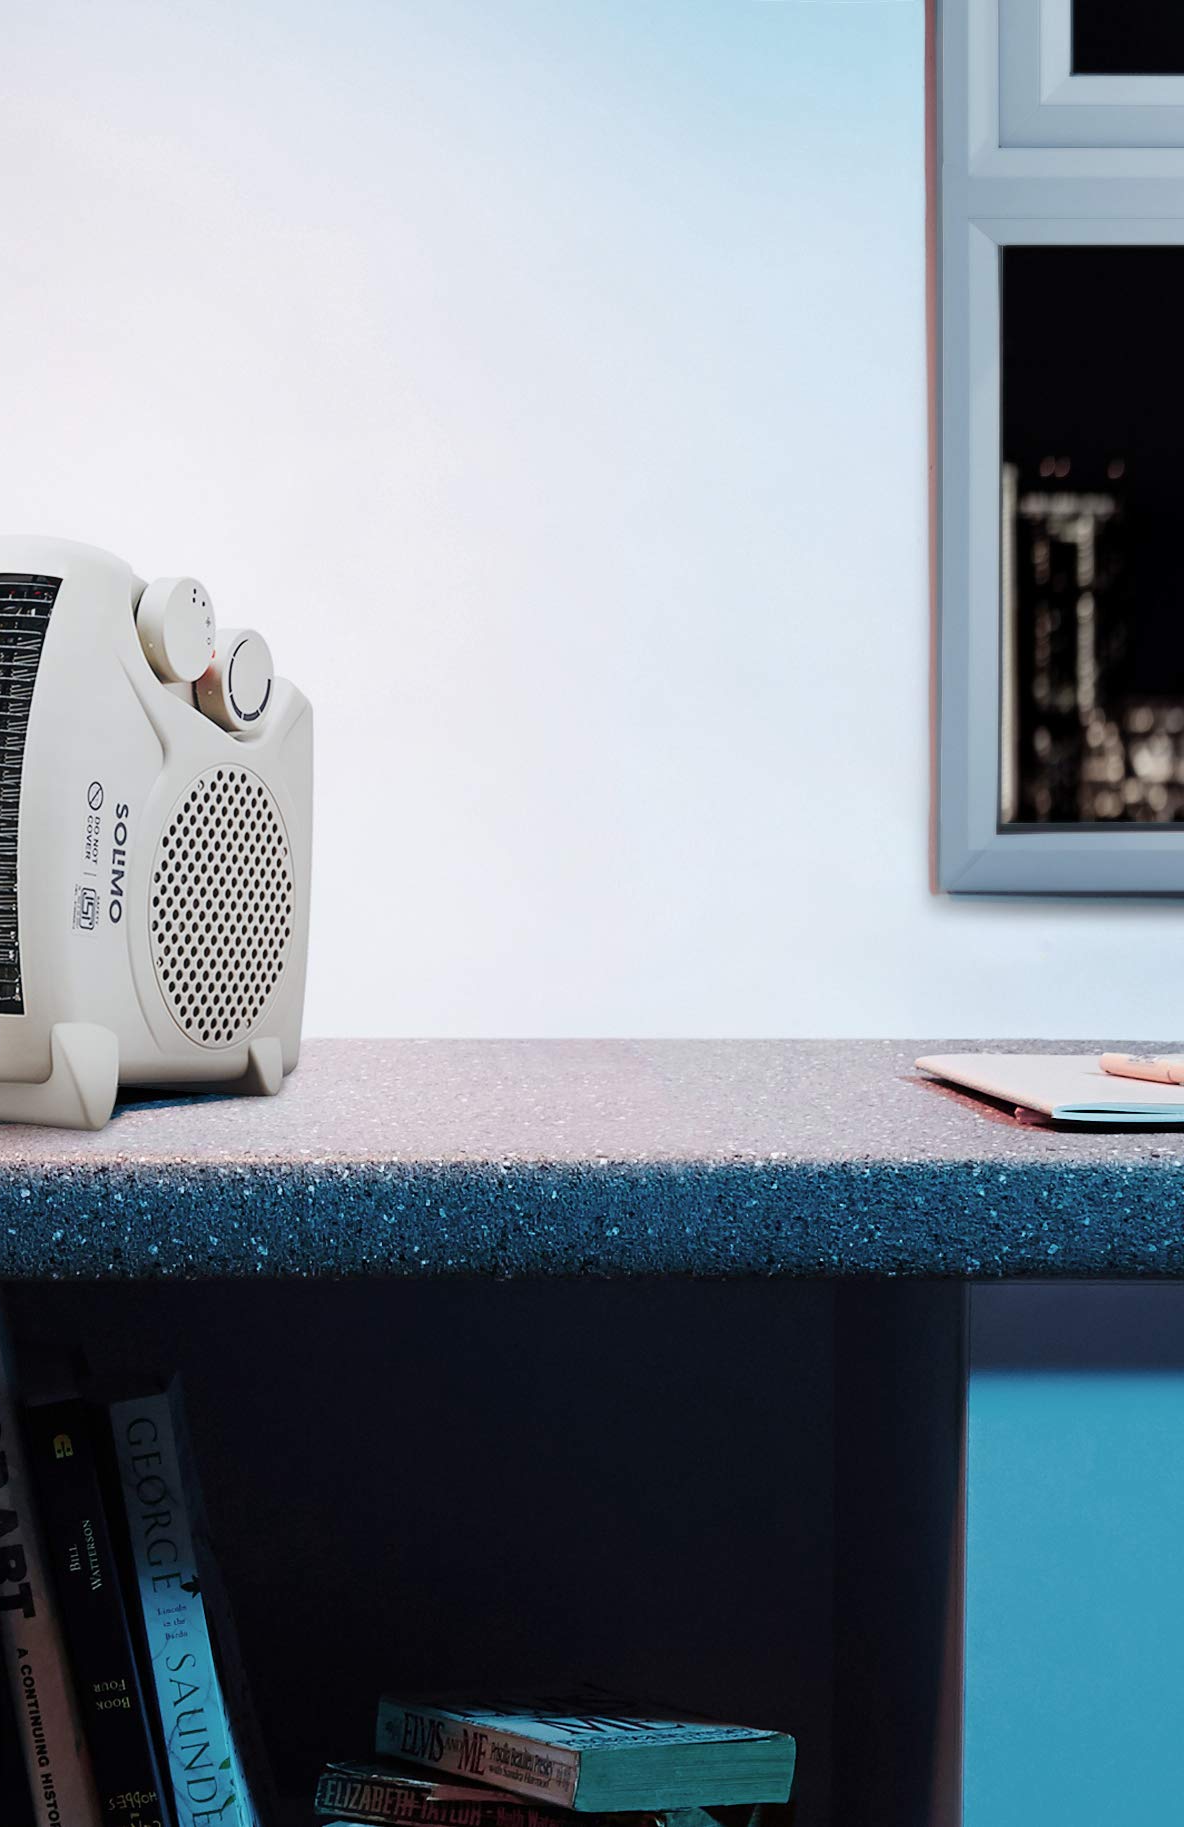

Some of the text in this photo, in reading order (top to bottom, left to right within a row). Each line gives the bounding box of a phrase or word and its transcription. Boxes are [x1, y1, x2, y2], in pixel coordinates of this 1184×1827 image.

[85, 815, 94, 860] COVER
[93, 816, 101, 835] DO
[109, 803, 129, 924] SOLIMO
[127, 1418, 182, 1593] GEORGE
[68, 1543, 81, 1572] BILL
[82, 1519, 104, 1592] WATTERSON
[17, 1648, 29, 1660] A
[93, 1679, 128, 1693] FOUR
[96, 1697, 131, 1711] BOOK
[21, 1664, 50, 1768] CONTINUING
[401, 1712, 445, 1762] ELVIS
[458, 1729, 488, 1775] ME
